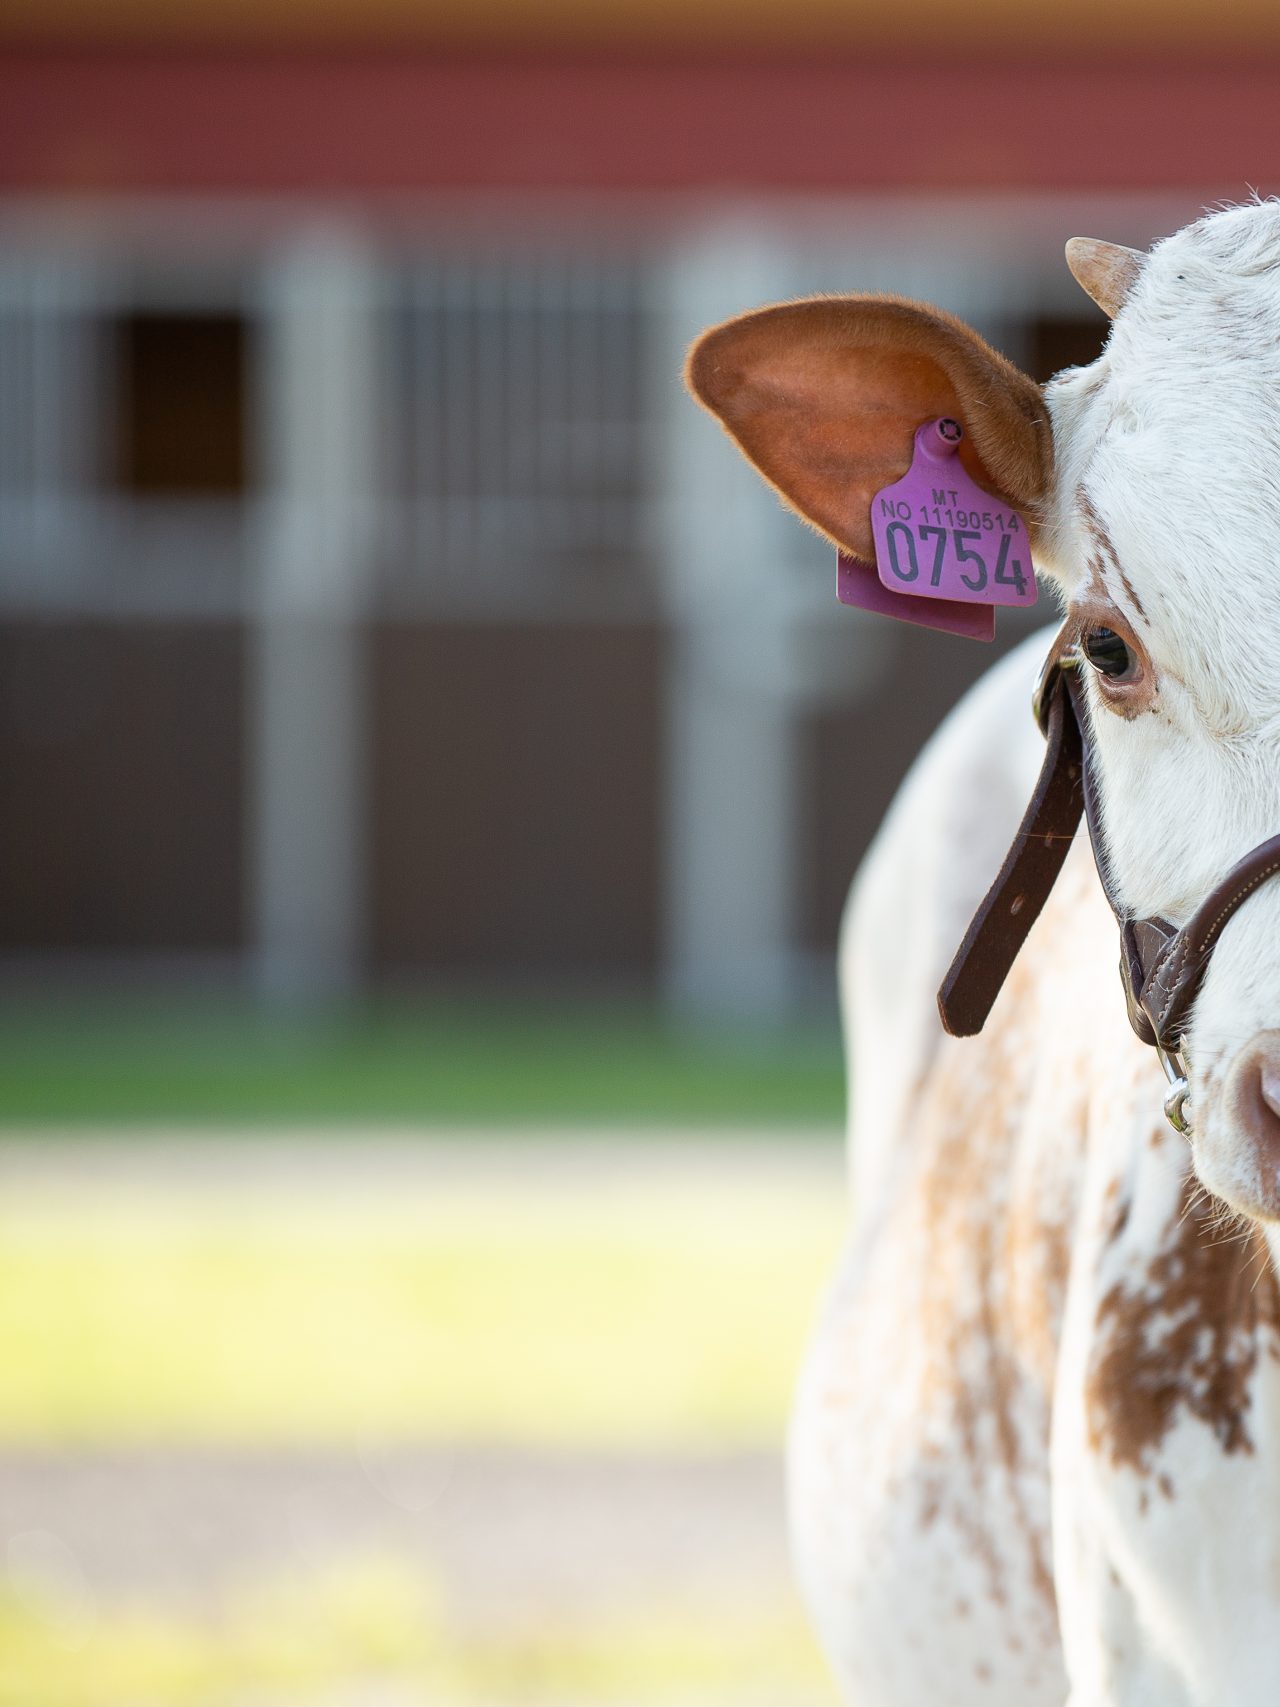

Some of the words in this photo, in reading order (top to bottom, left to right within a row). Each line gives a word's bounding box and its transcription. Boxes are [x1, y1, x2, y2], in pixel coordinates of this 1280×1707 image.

[931, 488, 959, 507] MT
[880, 498, 912, 521] NO
[919, 505, 1019, 533] 11190514
[885, 520, 1028, 596] 0754
